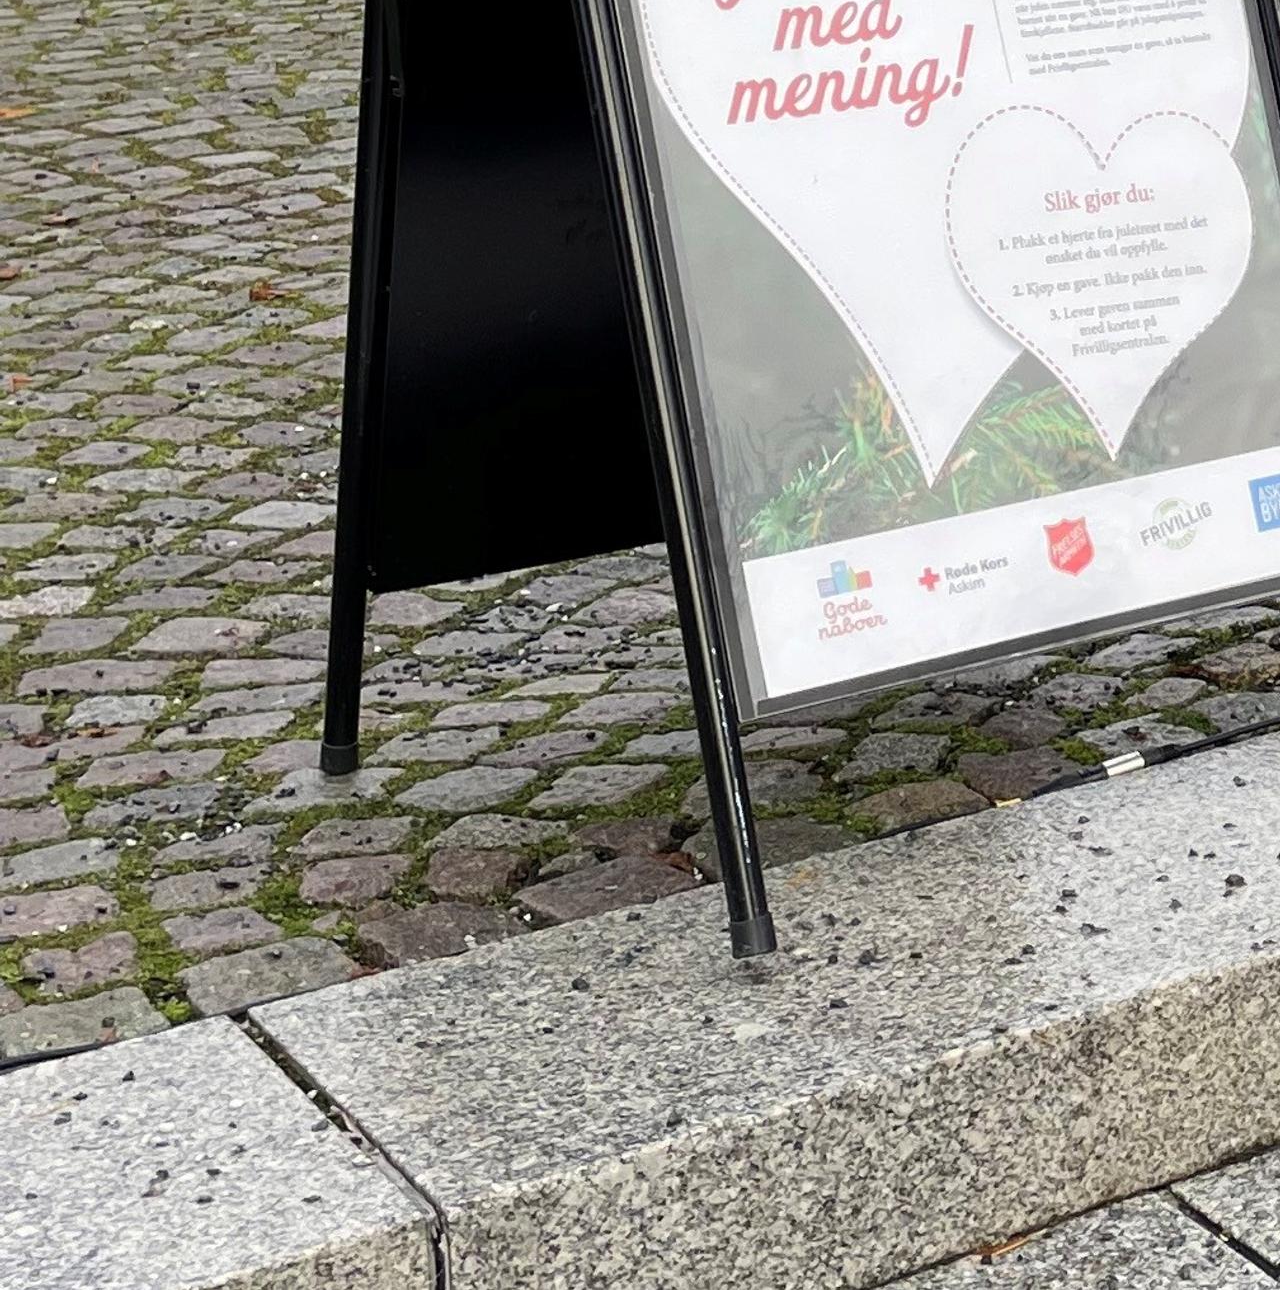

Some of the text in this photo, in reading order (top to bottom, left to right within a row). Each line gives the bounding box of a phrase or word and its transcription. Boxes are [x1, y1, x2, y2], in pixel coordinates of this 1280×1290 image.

[727, 24, 974, 127] mening!
[1044, 183, 1155, 213] Slik gjør du:
[999, 215, 1208, 251] 1. Plukk et hjerte fra juletreet med det
[1045, 238, 1169, 265] ønsket du vil oppfylle.
[1012, 262, 1207, 298] 2. Kjøp en gave. Ikke pakk den inn.
[1050, 294, 1180, 322] 3. Lever gaven sammen
[1079, 315, 1157, 337] med kortet på
[1072, 333, 1169, 357] Frivilligsentralen.
[1140, 501, 1212, 546] FRIVILLIG
[979, 555, 1009, 573] Kors
[948, 577, 986, 595] Askim
[823, 596, 873, 620] Gode
[818, 613, 888, 640] naboer
